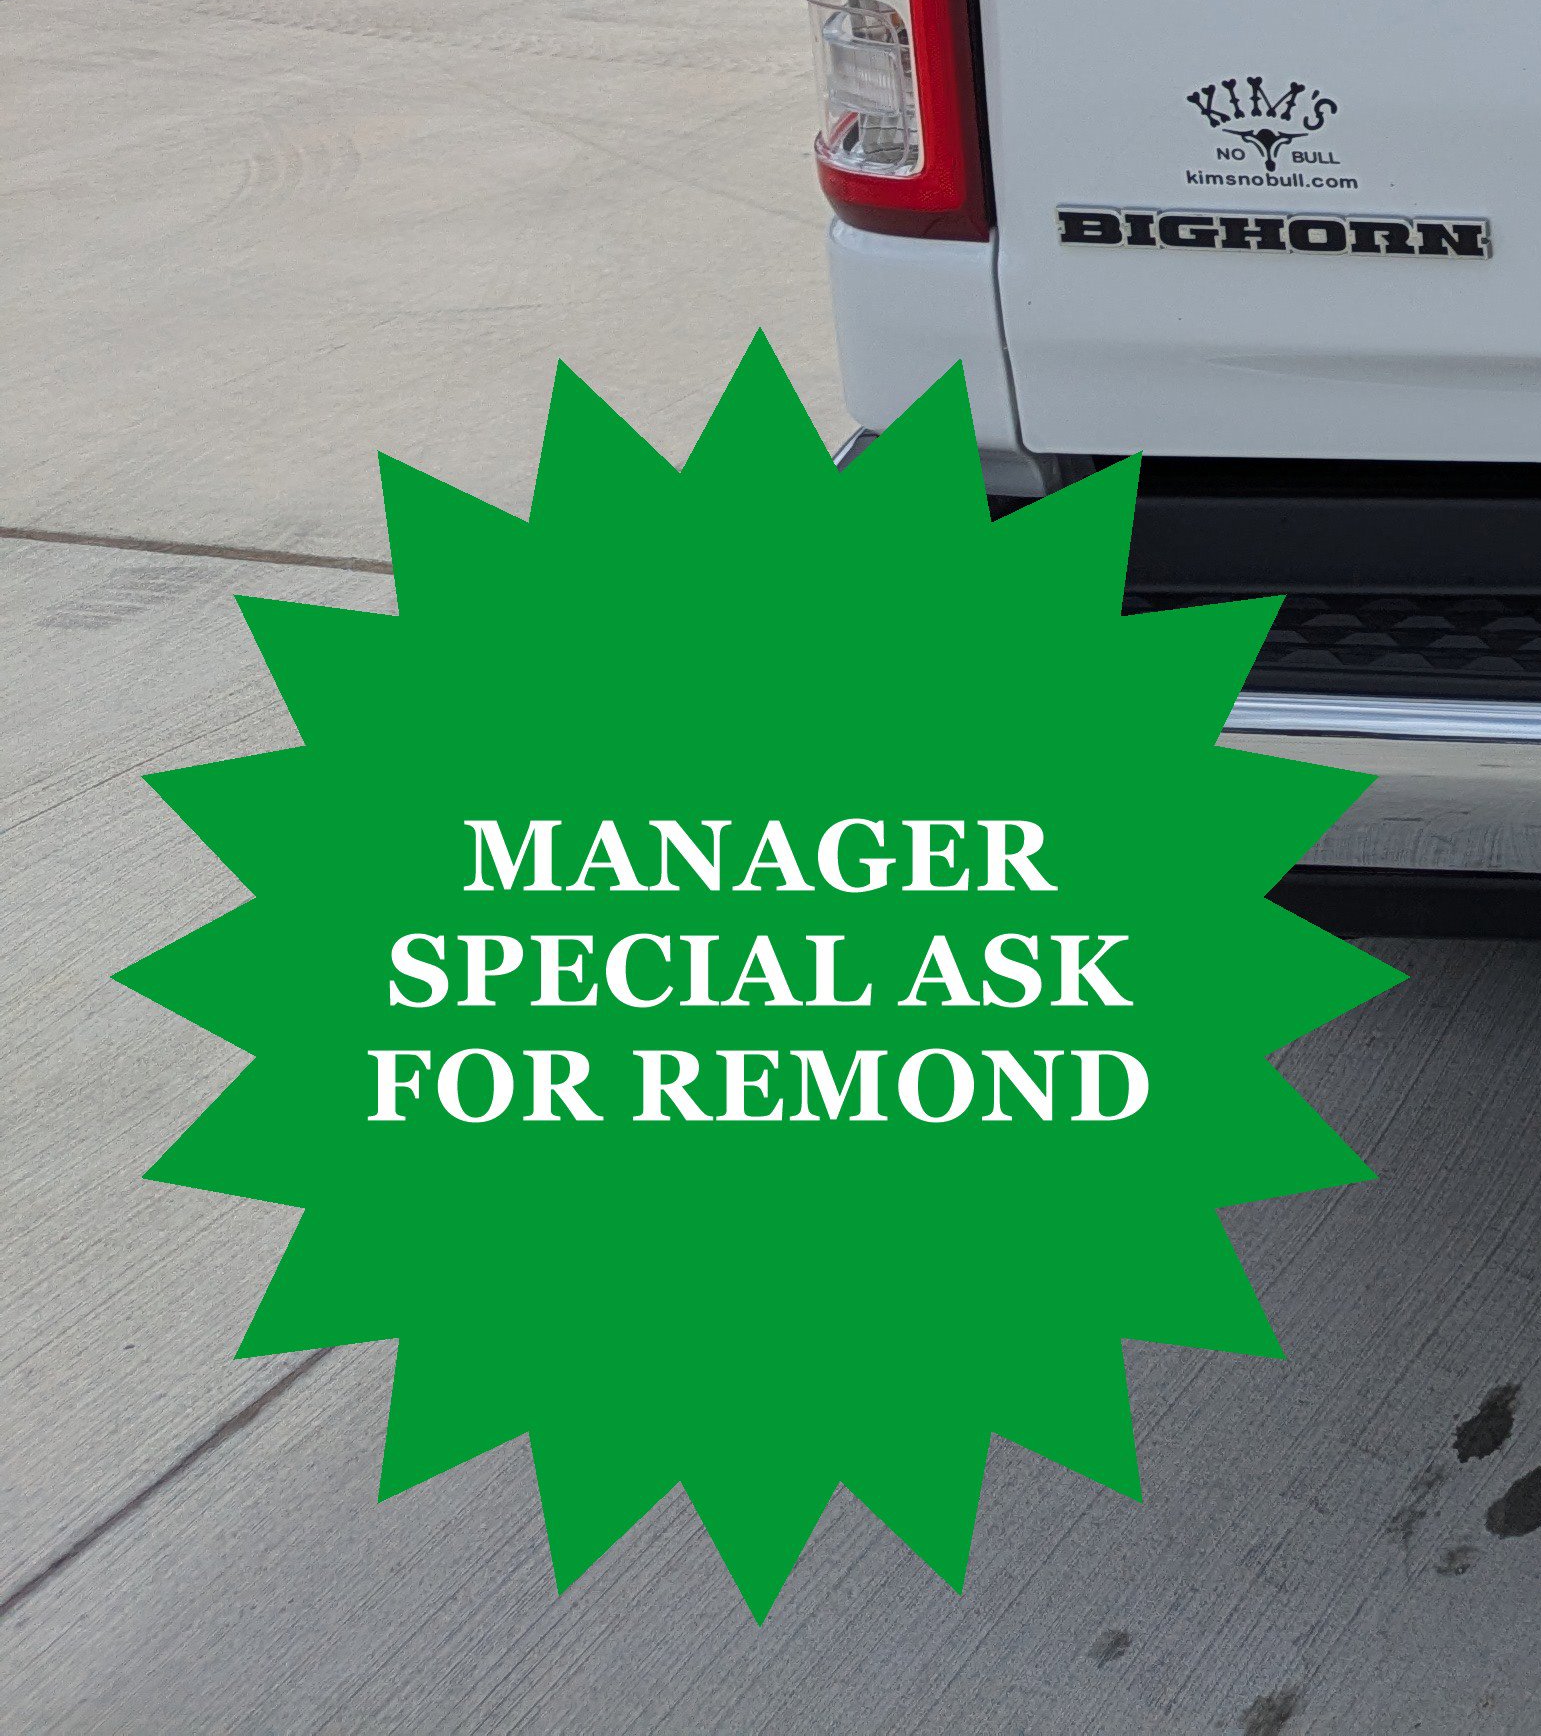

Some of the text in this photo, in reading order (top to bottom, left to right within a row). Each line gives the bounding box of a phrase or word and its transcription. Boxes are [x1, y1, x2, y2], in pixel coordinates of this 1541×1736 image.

[1187, 76, 1338, 131] KIM'S
[1216, 146, 1341, 165] NO BULL
[1185, 169, 1359, 190] kimsnobull.com
[1057, 206, 1492, 259] BIGHORN
